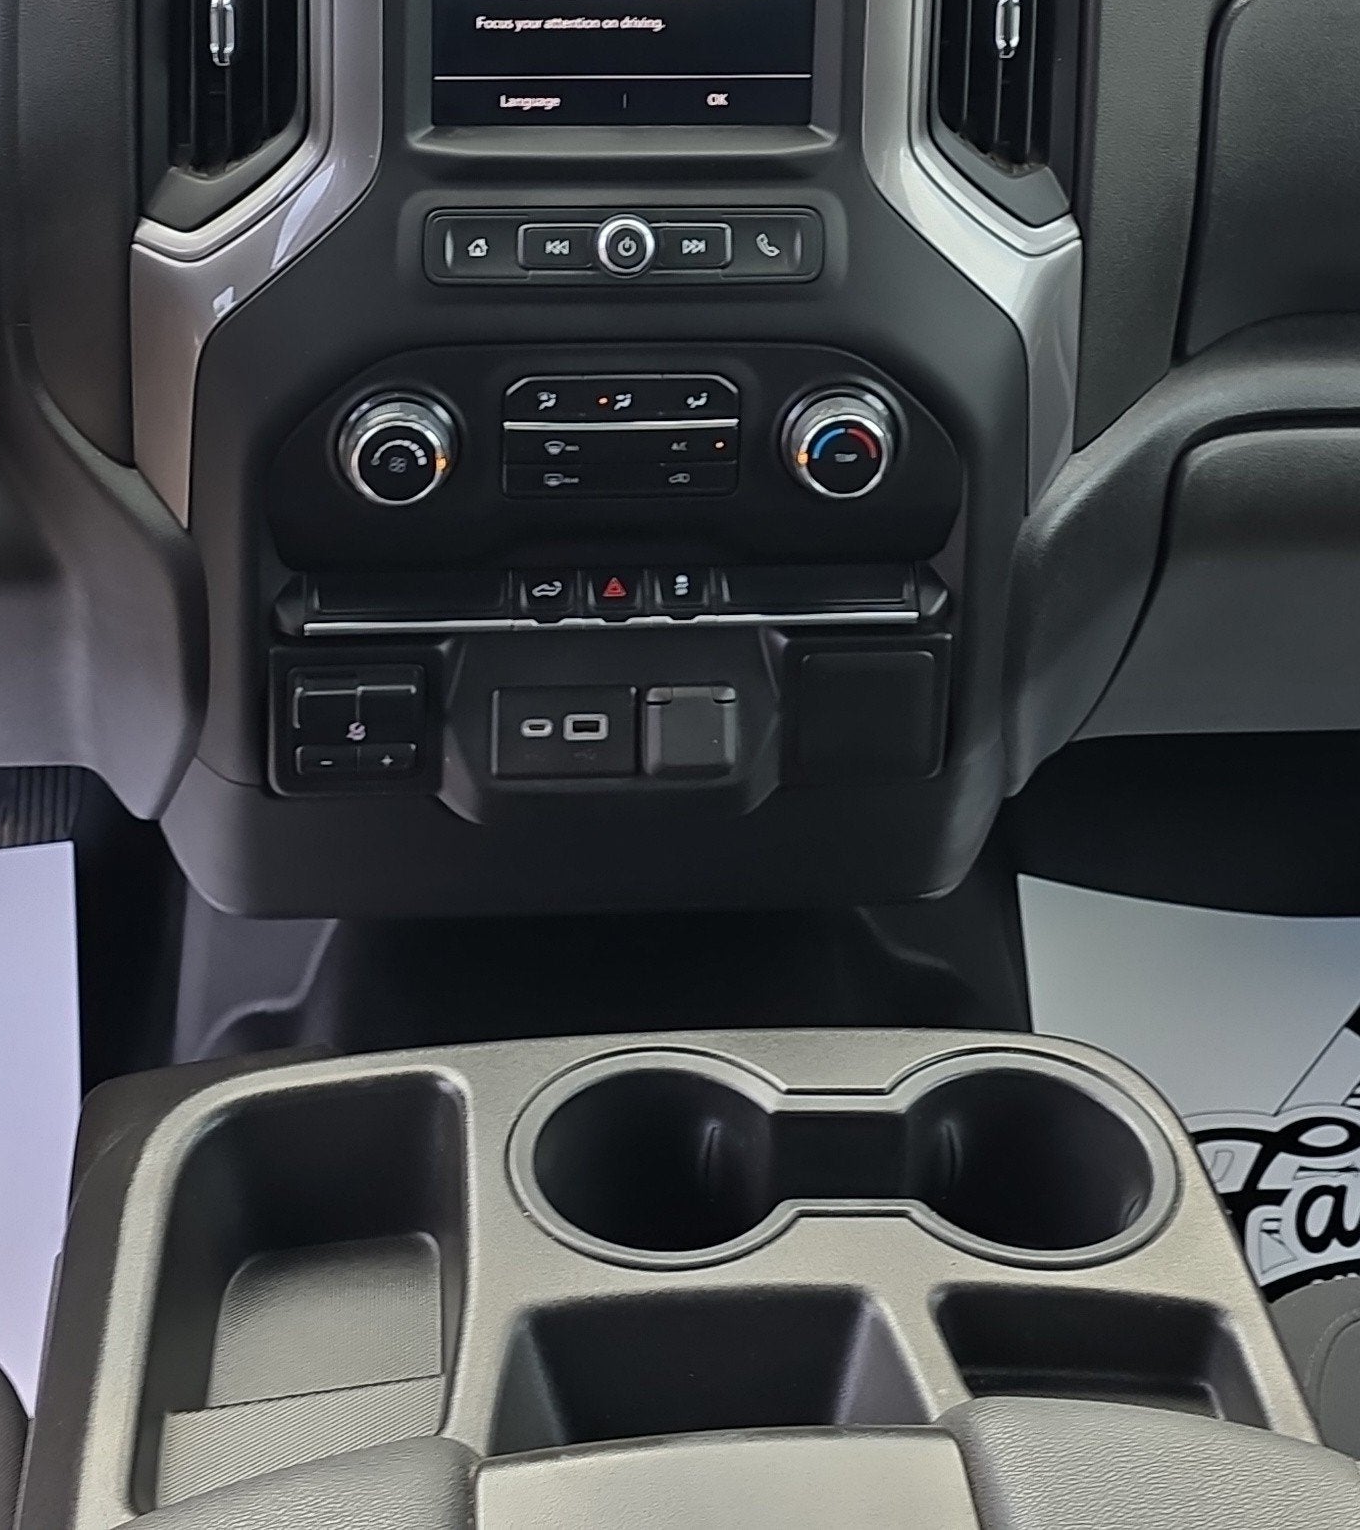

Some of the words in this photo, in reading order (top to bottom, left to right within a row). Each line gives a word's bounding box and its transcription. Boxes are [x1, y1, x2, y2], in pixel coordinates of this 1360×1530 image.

[476, 16, 514, 29] Focus
[514, 19, 543, 32] your
[544, 16, 600, 29] attention
[601, 19, 619, 29] on
[620, 16, 666, 32] driving.
[500, 93, 561, 111] Language
[707, 92, 729, 106] OK
